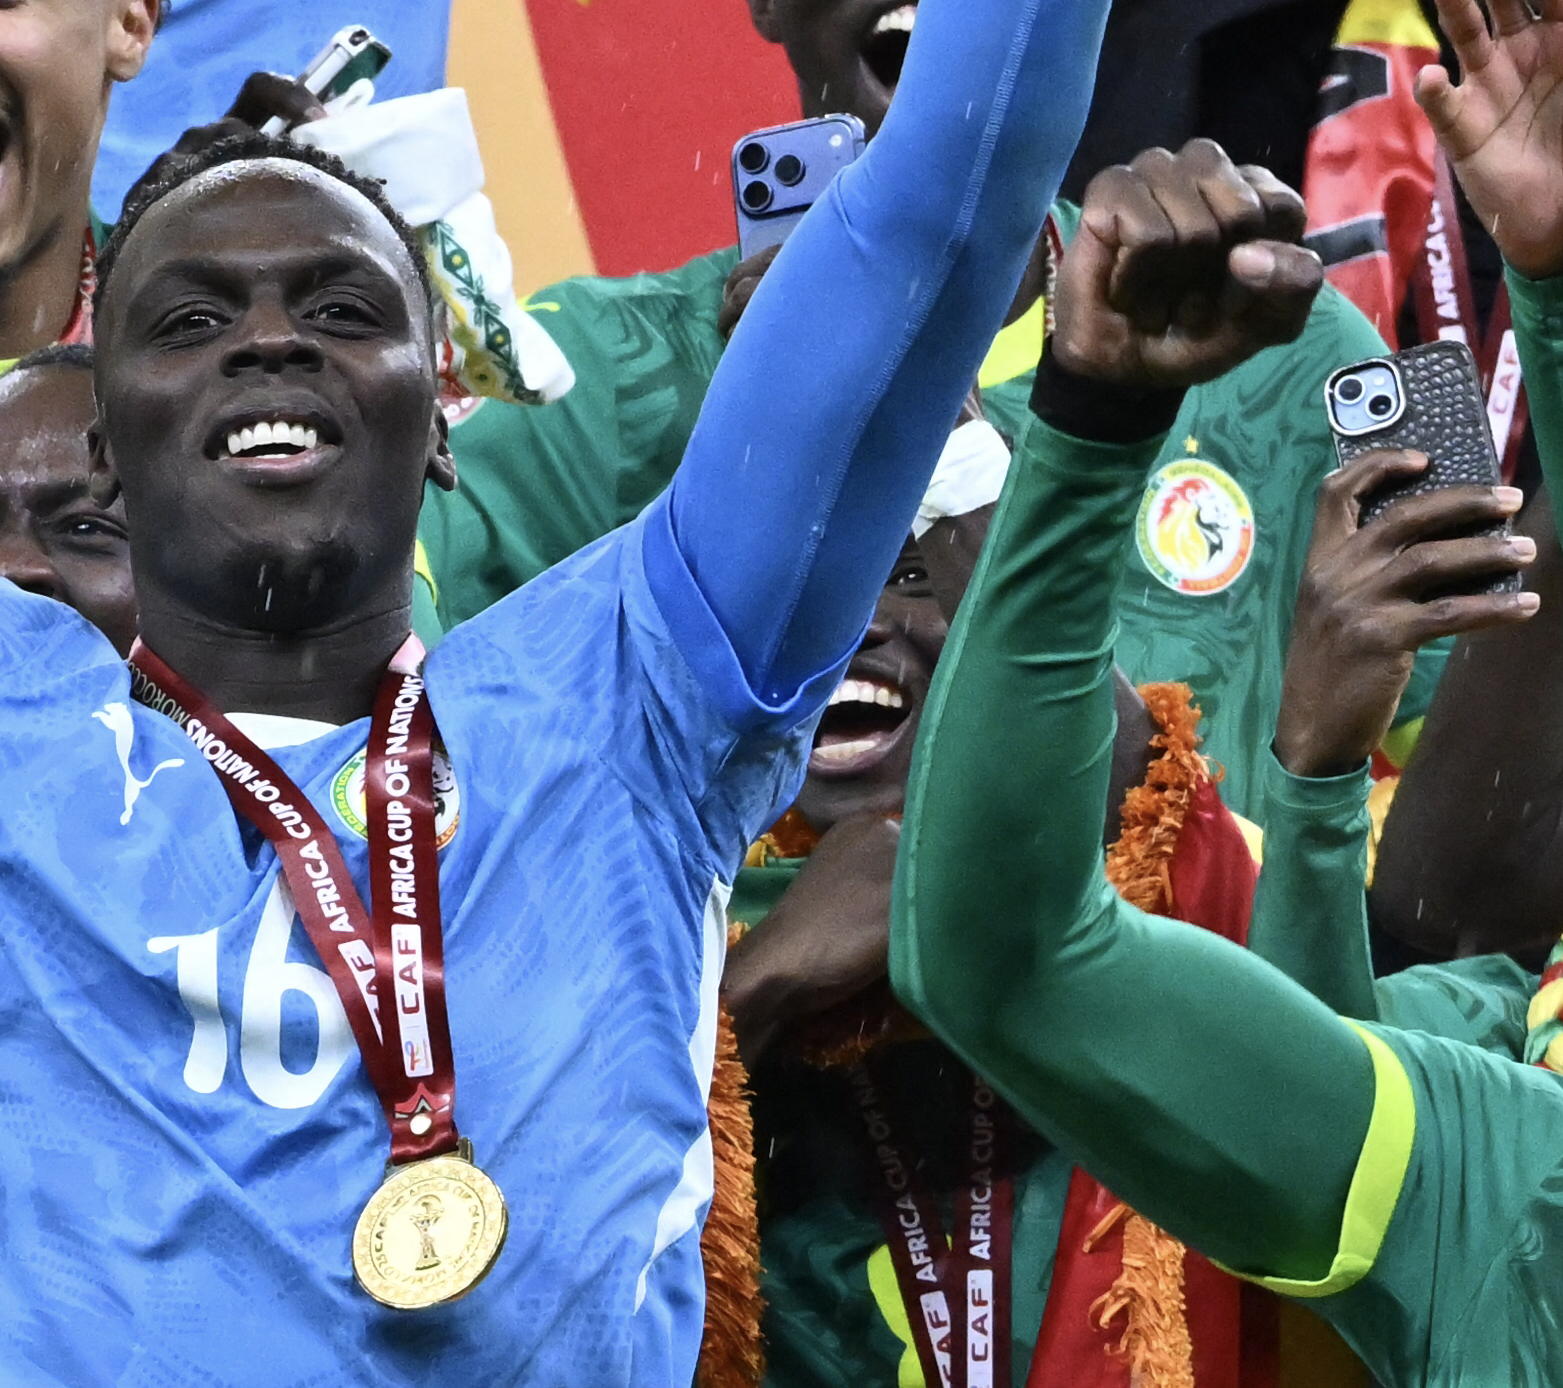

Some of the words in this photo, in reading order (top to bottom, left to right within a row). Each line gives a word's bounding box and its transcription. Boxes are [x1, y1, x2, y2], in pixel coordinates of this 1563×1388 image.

[186, 717, 260, 785] NATIONS
[385, 675, 426, 756] NATIONS
[246, 778, 281, 804] OF
[385, 758, 411, 798] OF
[268, 801, 312, 840] CUP
[387, 801, 413, 843] CUP
[300, 839, 355, 933] AFRICA
[390, 843, 417, 919] AFRICA
[147, 869, 363, 1109] 16
[397, 938, 421, 1015] CAF
[896, 1196, 938, 1284] AFRICA
[969, 1166, 992, 1262] AFRICA
[971, 1287, 990, 1363] CAF
